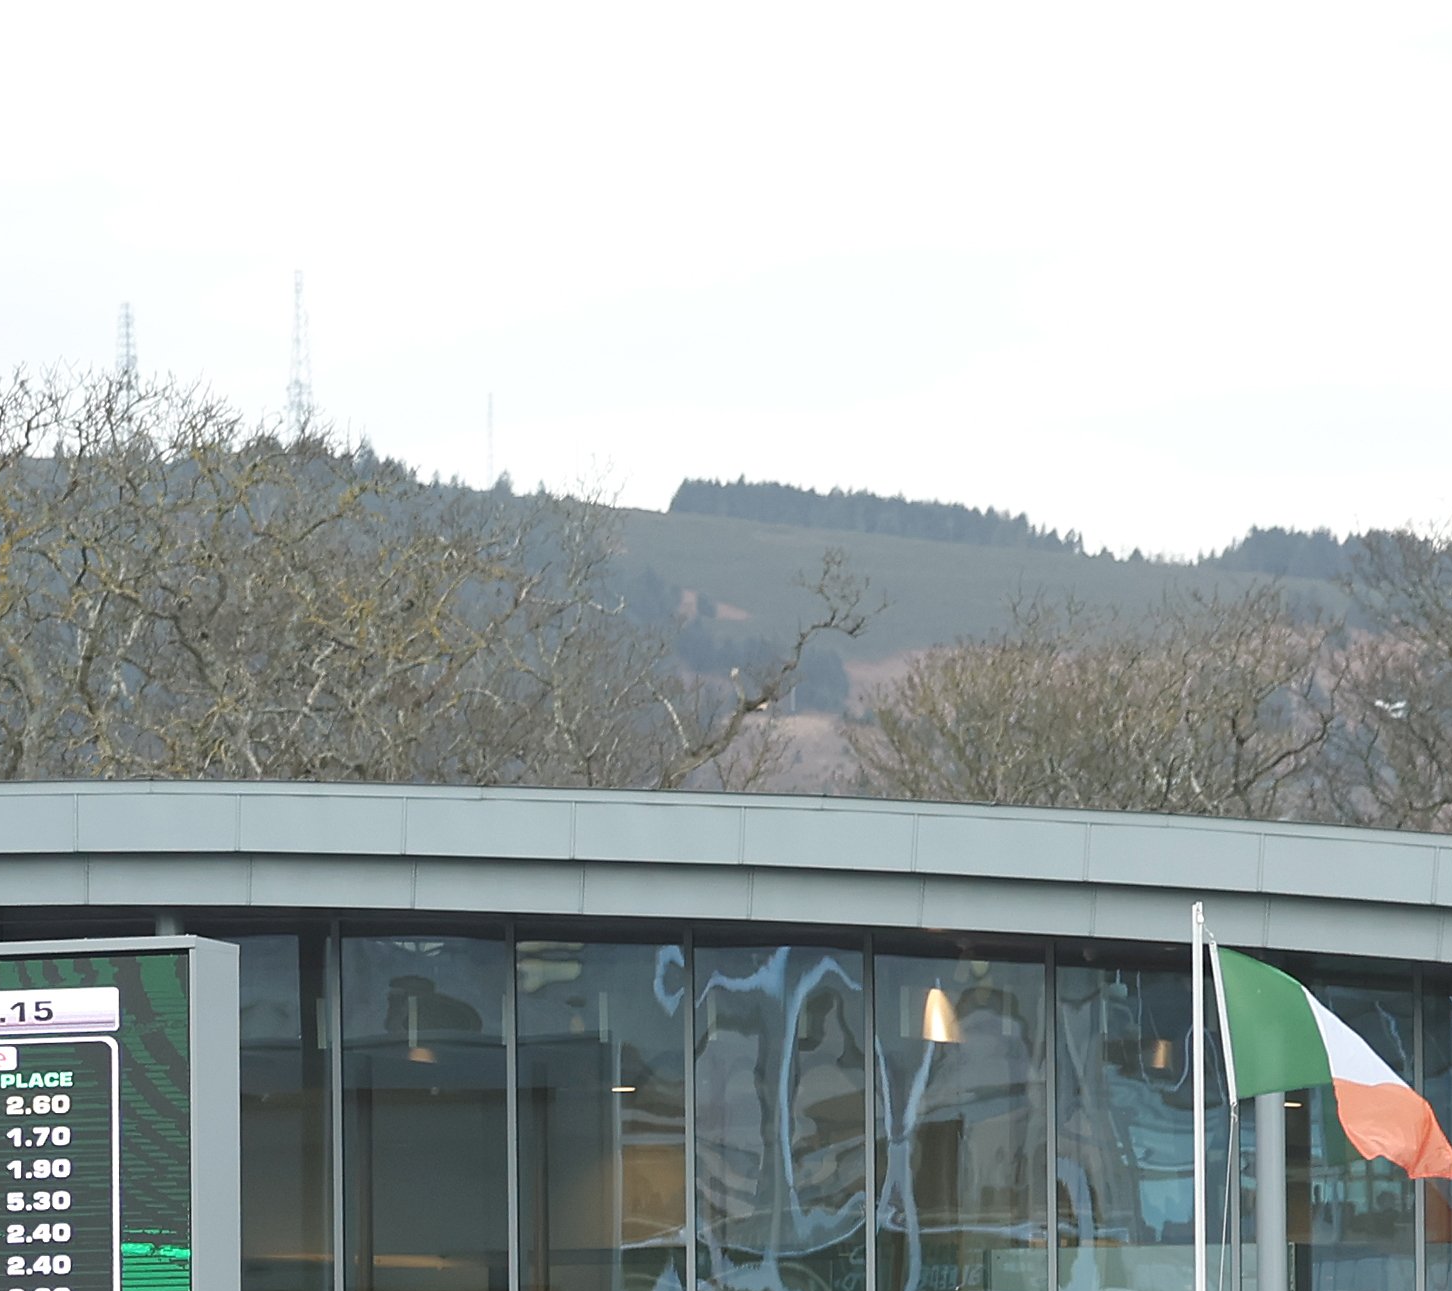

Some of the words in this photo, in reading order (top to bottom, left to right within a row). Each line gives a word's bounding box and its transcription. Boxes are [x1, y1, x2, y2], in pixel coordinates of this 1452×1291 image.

[0, 1071, 74, 1089] PLACE
[7, 1094, 71, 1115] 2.60
[7, 1126, 71, 1148] 1.70
[7, 1158, 71, 1179] 1.90
[7, 1190, 71, 1212] 5.30
[7, 1222, 71, 1244] 2.40
[7, 1254, 72, 1276] 2.40
